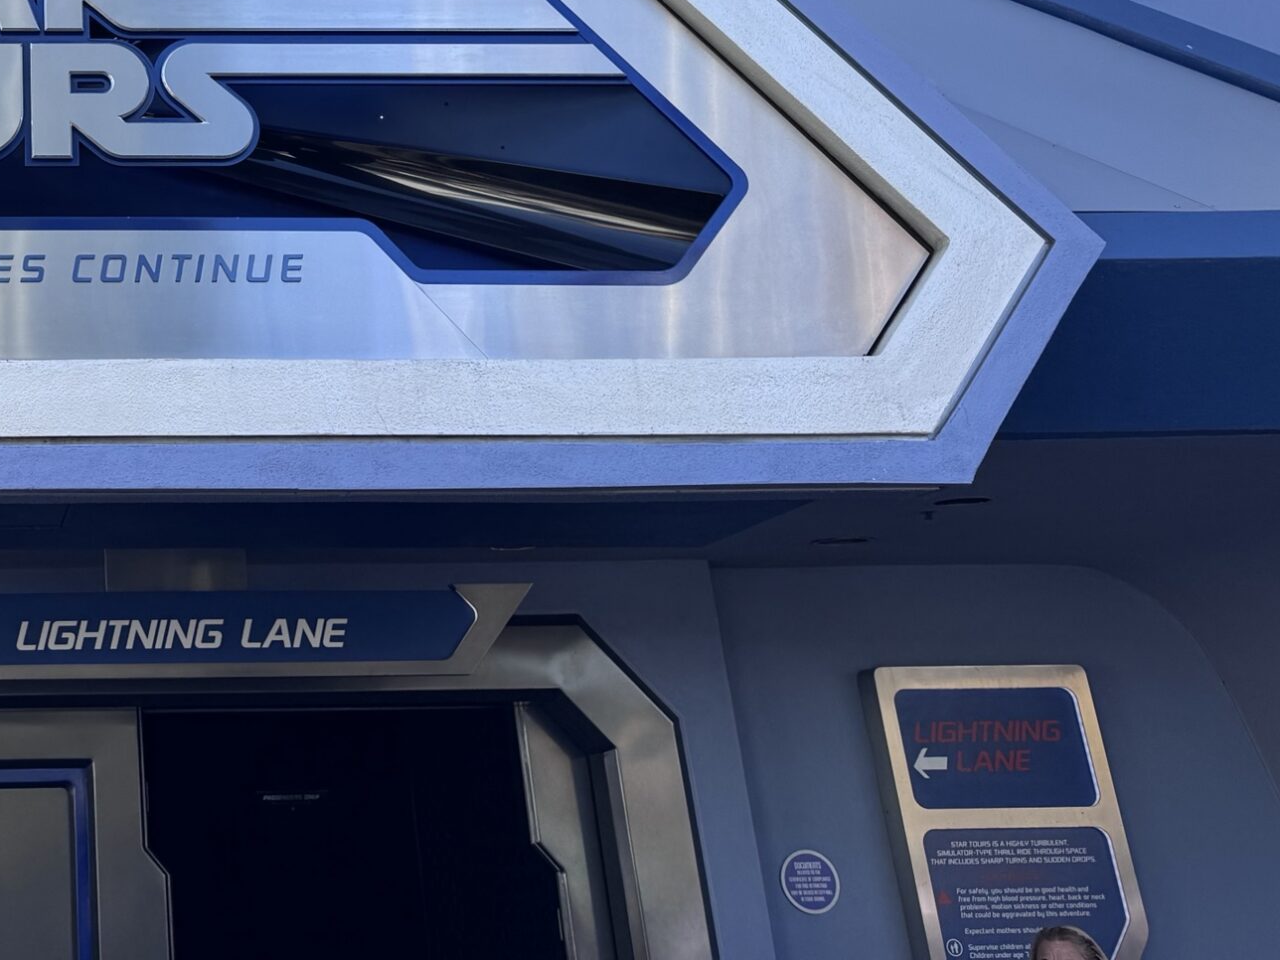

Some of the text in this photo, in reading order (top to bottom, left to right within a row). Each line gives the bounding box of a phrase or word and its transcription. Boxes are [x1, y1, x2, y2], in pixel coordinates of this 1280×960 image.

[72, 253, 304, 285] CONTINUE
[16, 618, 348, 651] LIGHTNING LANE
[914, 719, 1062, 743] LIGHTNING
[956, 749, 1031, 772] LANE
[1065, 847, 1088, 855] SPACE
[980, 857, 1004, 865] SHARP
[1040, 886, 1056, 894] good
[987, 895, 1001, 903] high
[1001, 911, 1036, 919] aggravated
[964, 927, 995, 936] Expectant
[967, 943, 998, 951] Supervise
